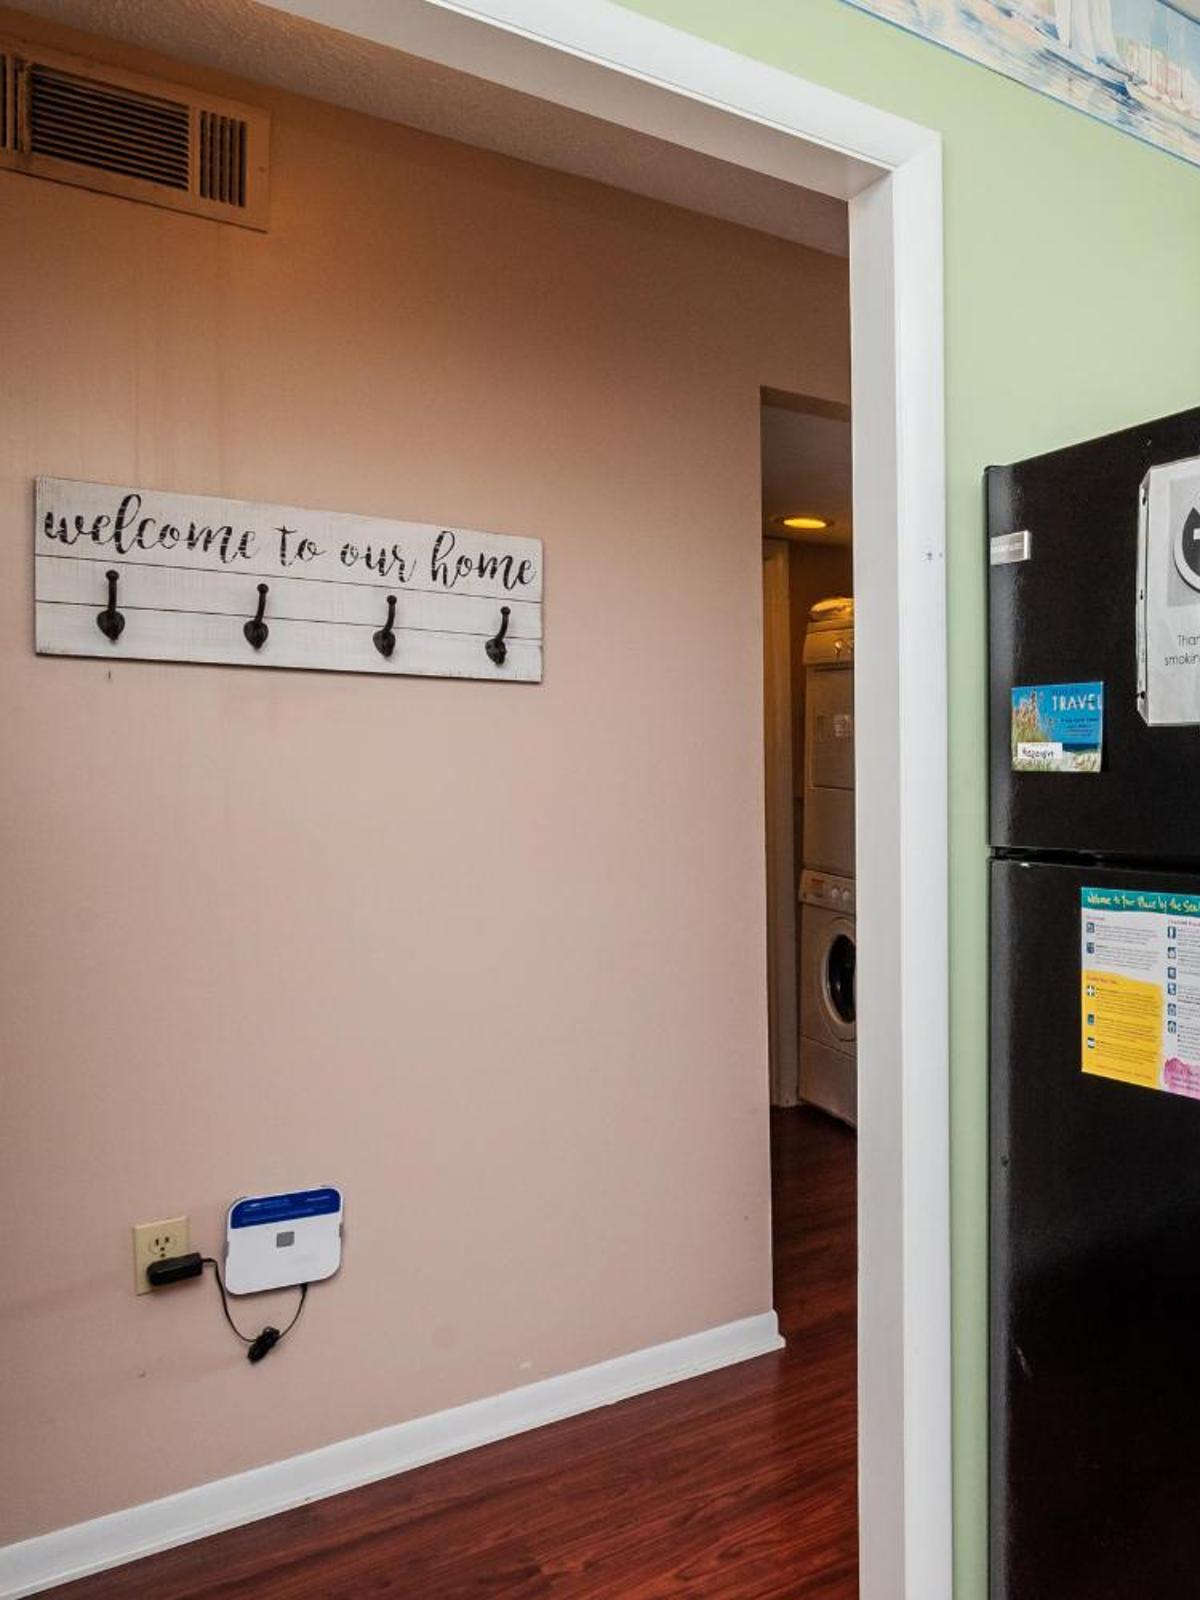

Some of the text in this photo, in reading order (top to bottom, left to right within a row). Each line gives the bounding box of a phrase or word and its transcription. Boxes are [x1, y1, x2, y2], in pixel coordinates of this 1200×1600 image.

[43, 494, 537, 590] welcome to our home
